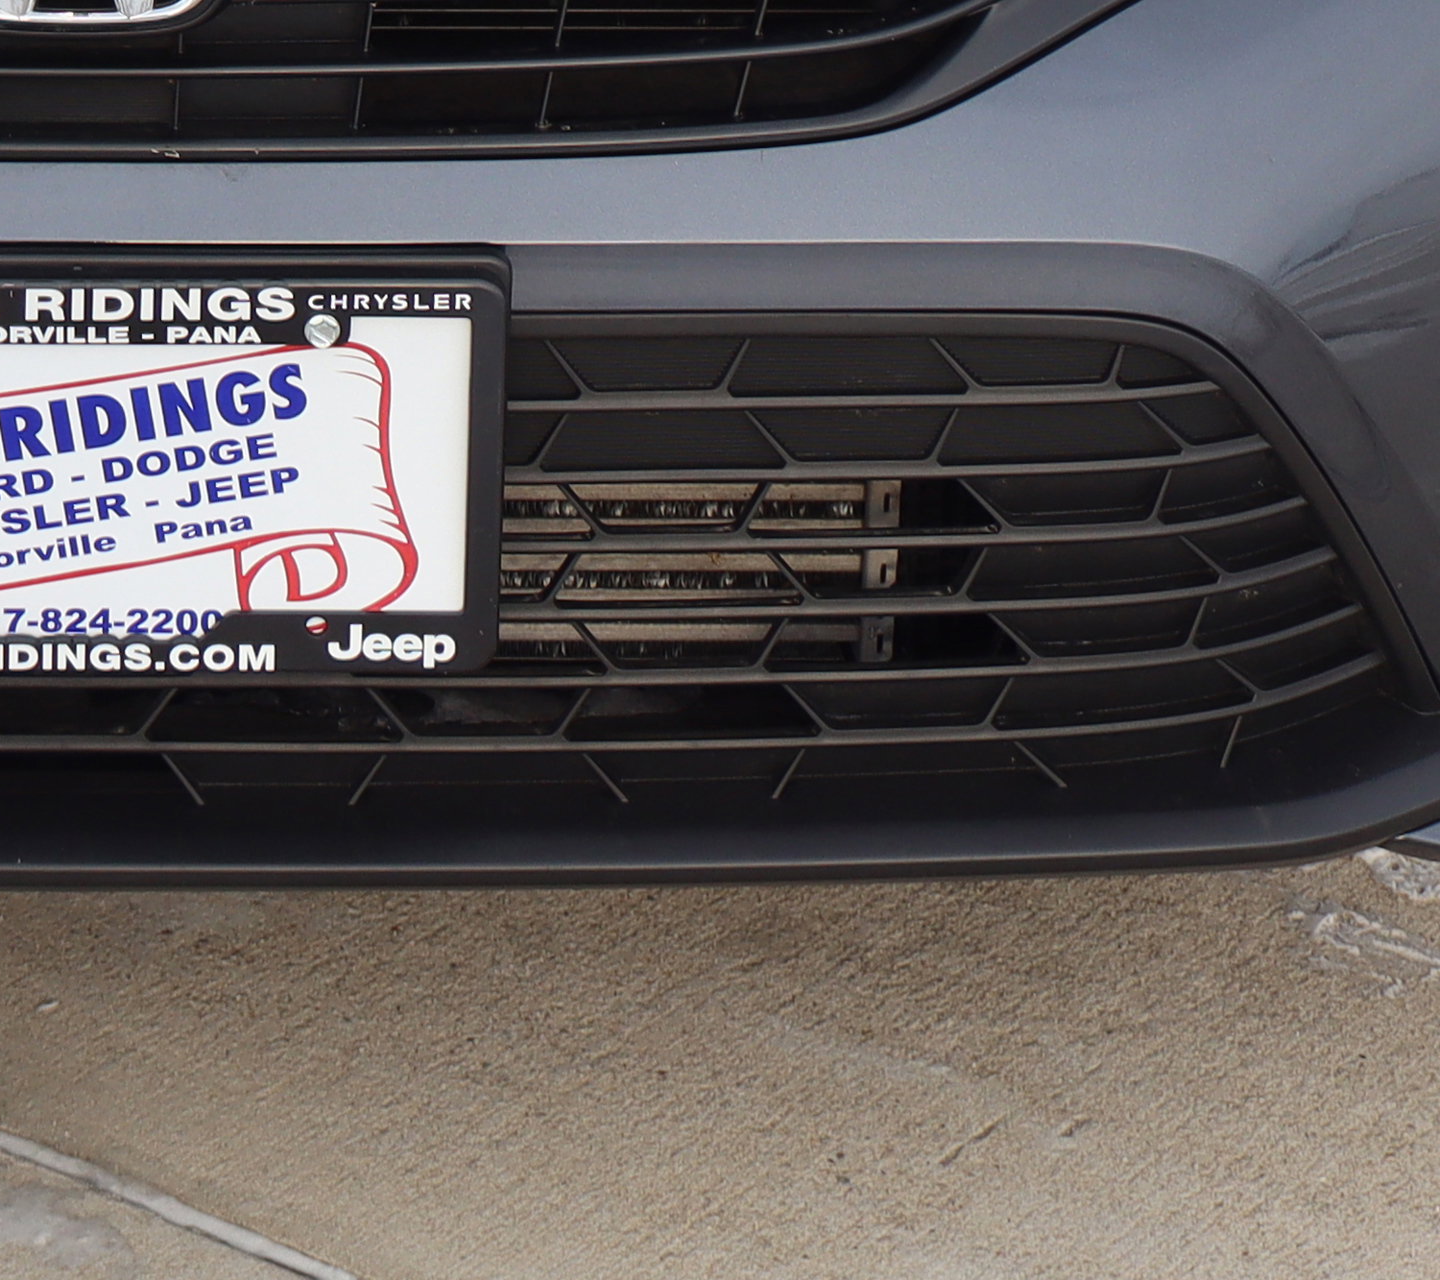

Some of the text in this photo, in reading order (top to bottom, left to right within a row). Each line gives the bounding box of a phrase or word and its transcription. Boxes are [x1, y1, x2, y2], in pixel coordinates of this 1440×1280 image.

[24, 286, 295, 322] RIDINGS
[307, 293, 472, 311] CHRYSLER
[166, 325, 262, 344] PANA
[101, 434, 277, 483] DODGE
[175, 467, 299, 508] JEEP
[154, 515, 253, 543] Pana
[328, 624, 456, 668] Jeep
